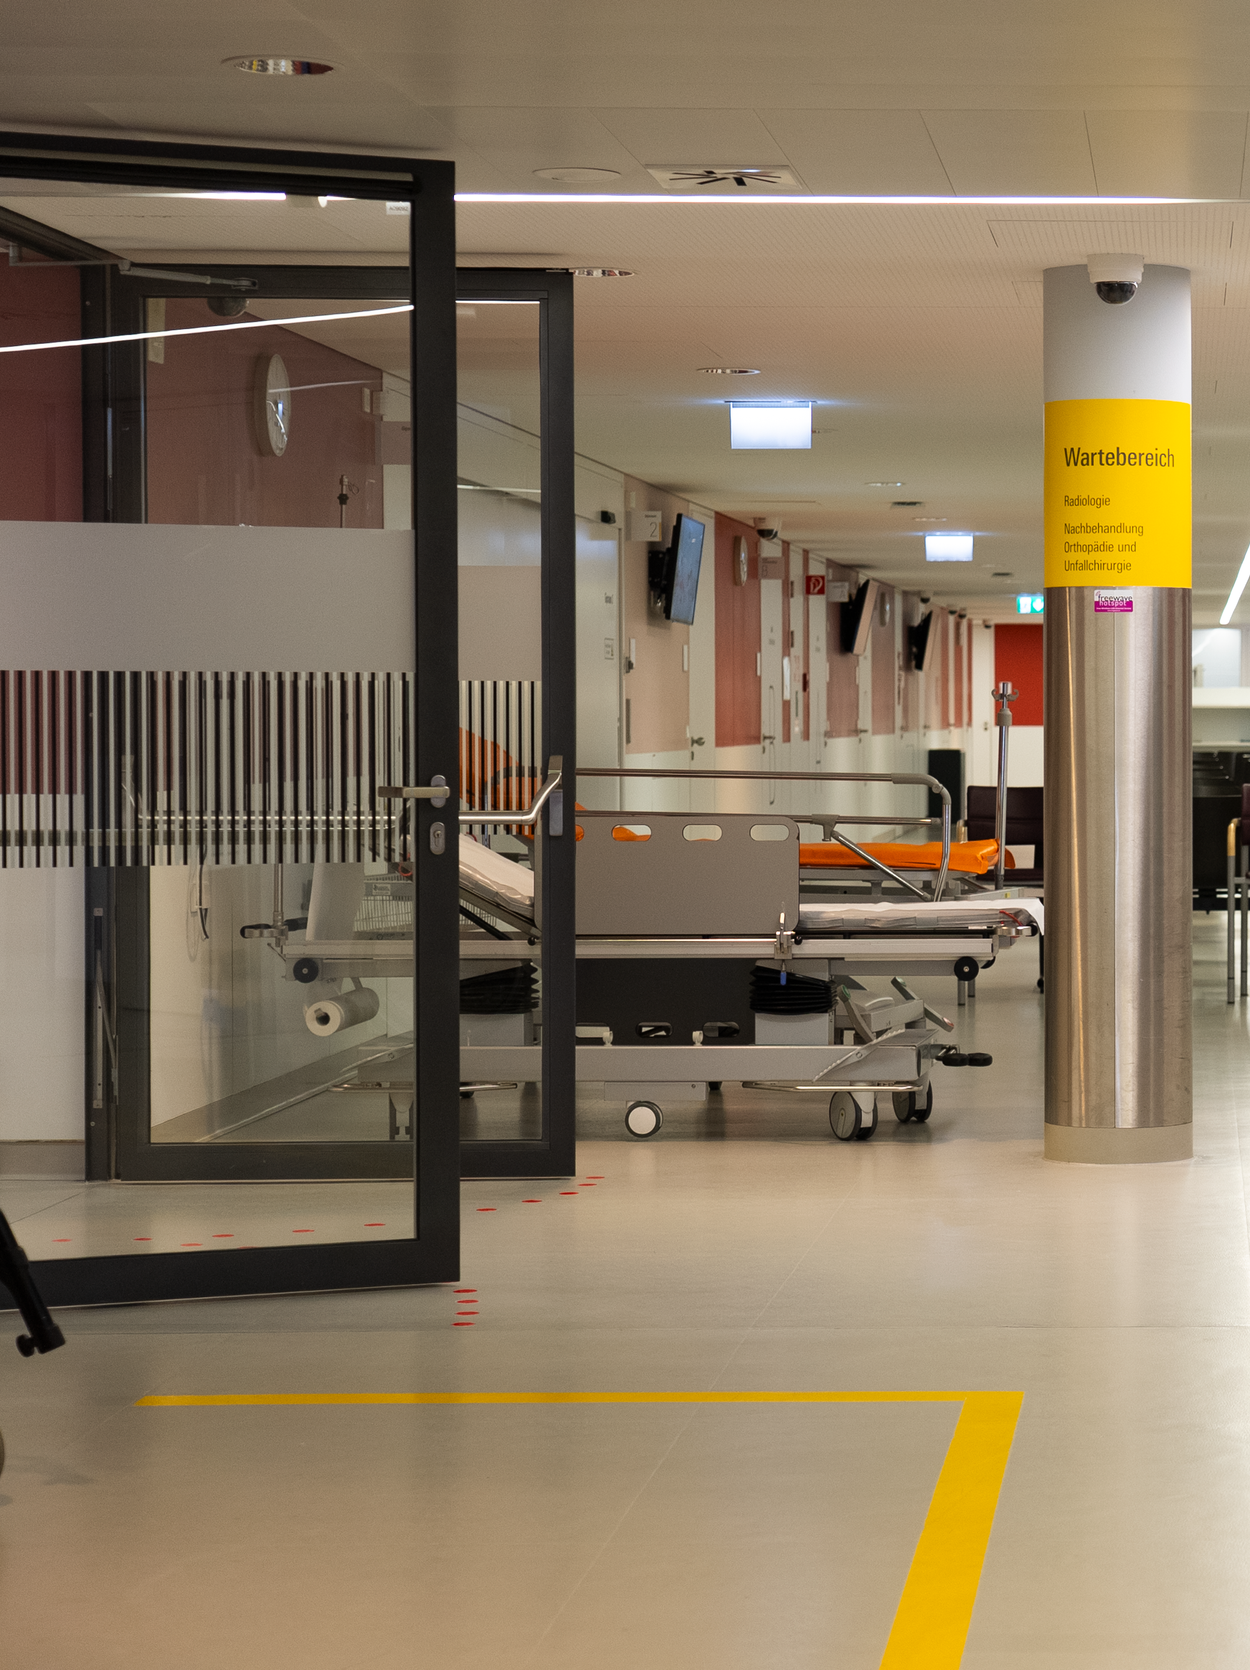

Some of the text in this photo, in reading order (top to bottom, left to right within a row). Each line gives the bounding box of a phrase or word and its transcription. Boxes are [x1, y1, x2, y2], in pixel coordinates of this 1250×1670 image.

[1064, 446, 1175, 468] Wartebereich
[1064, 494, 1111, 509] Radiologie
[650, 521, 658, 538] 2
[1064, 522, 1144, 537] Nachbehandlung
[1064, 540, 1137, 555] Orthopädie und
[1064, 559, 1132, 574] Unfallchirurgie
